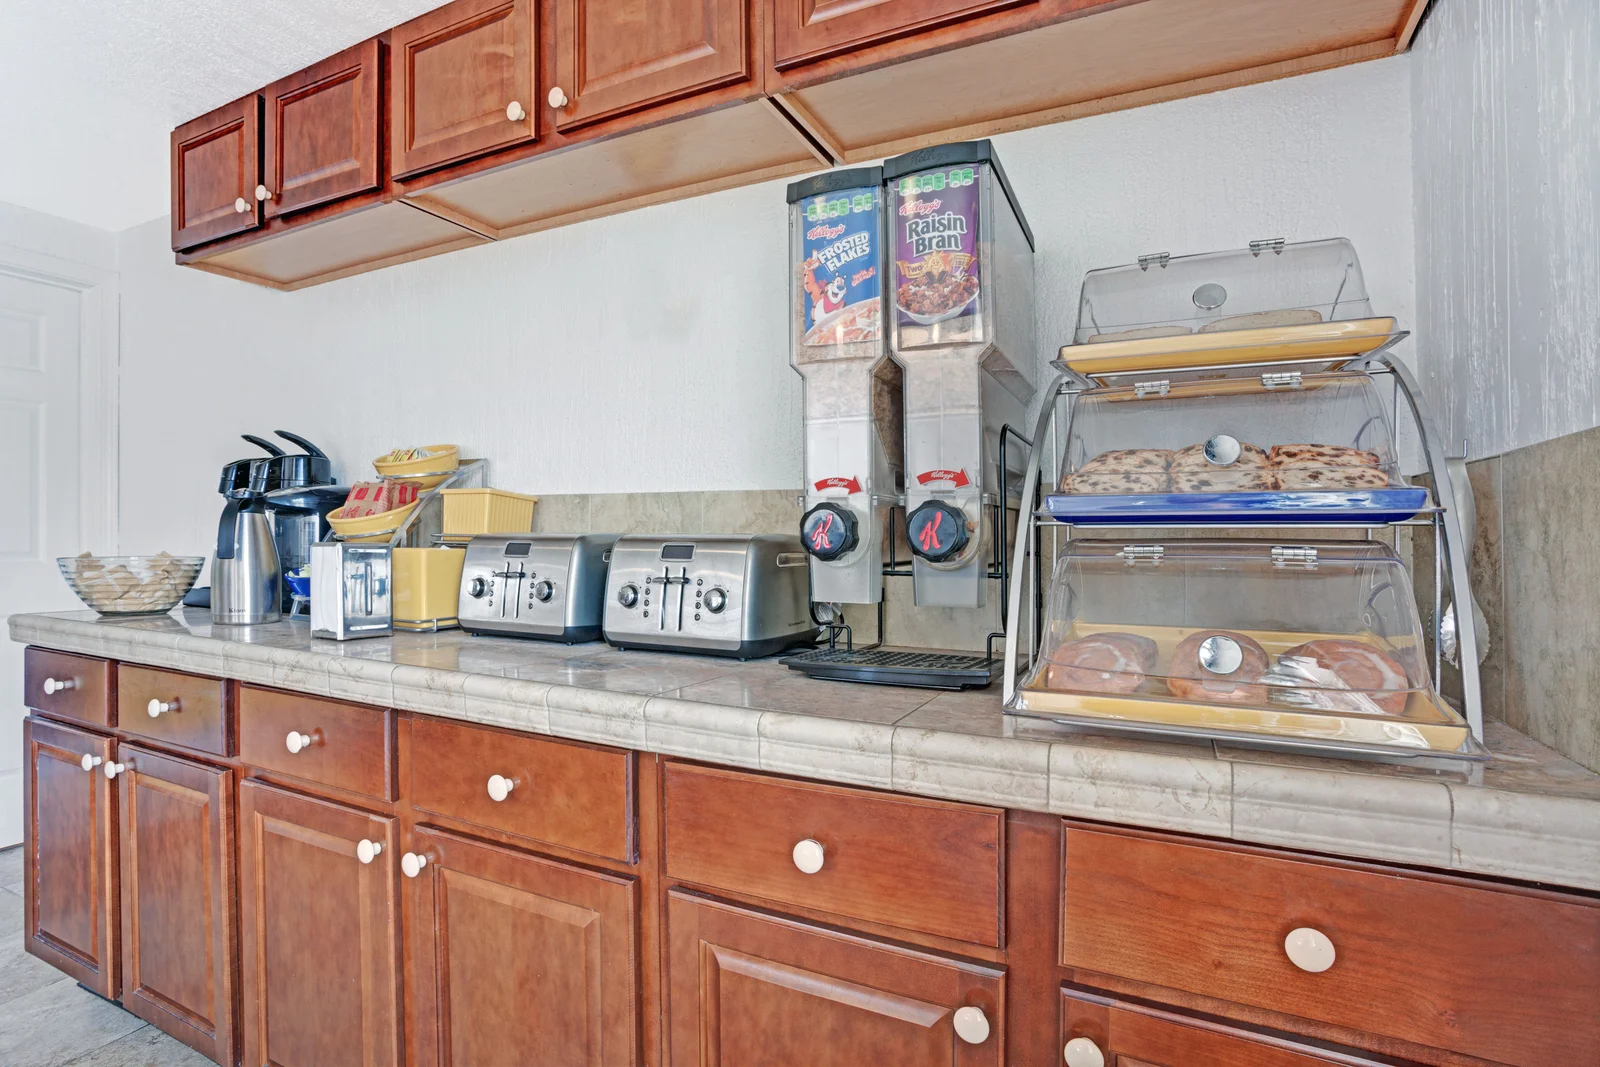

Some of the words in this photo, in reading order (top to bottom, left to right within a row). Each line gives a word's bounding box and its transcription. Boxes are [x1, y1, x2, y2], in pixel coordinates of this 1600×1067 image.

[899, 199, 942, 214] Kellogg's
[807, 224, 845, 240] Kellogg's
[907, 212, 966, 242] Raisin
[817, 232, 869, 266] FROSTED
[826, 243, 870, 272] FLAKES
[914, 234, 961, 256] Bran
[930, 471, 955, 480] Kellogg's
[812, 513, 833, 550] K
[918, 511, 941, 550] K
